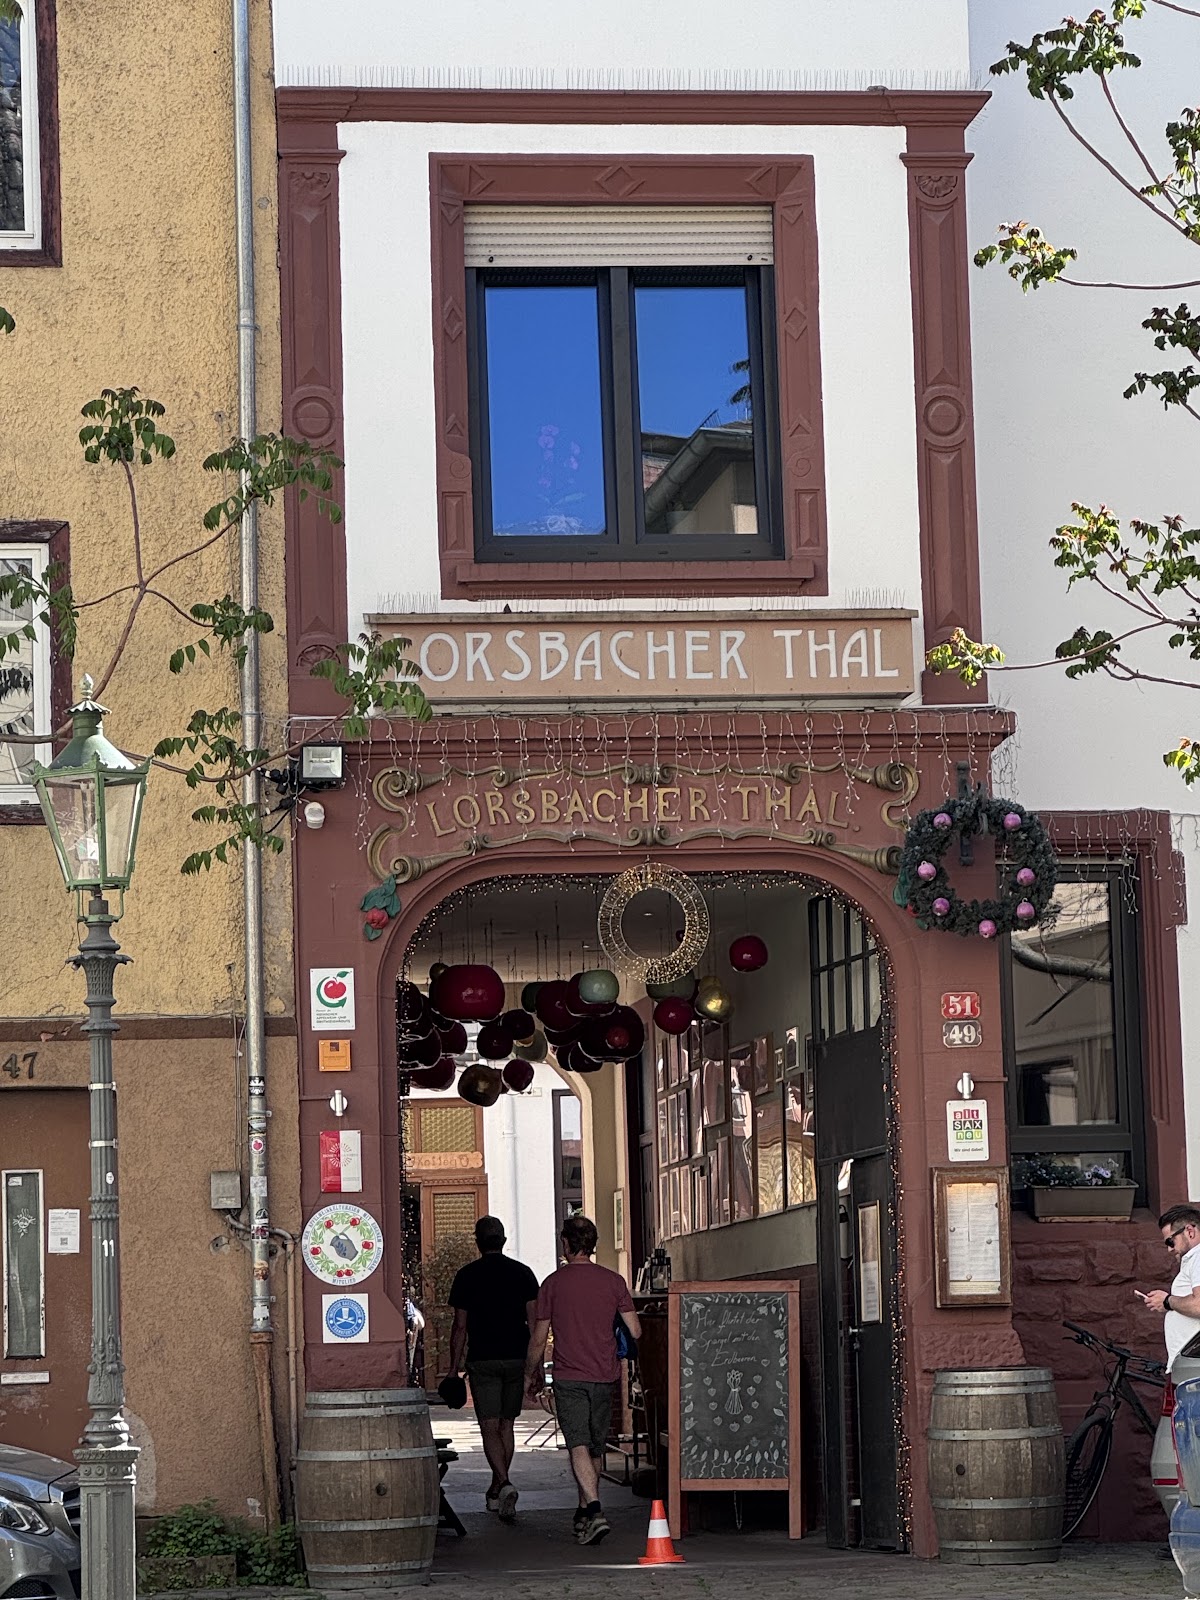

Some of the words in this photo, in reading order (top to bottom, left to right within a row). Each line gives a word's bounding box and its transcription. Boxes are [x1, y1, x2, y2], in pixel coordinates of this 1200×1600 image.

[773, 628, 899, 679] THAL
[425, 787, 711, 837] LORSBACHER
[948, 995, 974, 1016] 51
[949, 1024, 976, 1044] 49
[2, 1051, 39, 1079] 47
[954, 1109, 979, 1119] alt
[953, 1120, 982, 1130] SAX
[956, 1131, 982, 1140] neu
[102, 1239, 115, 1257] 11
[332, 1277, 357, 1285] MITGLIED
[745, 1310, 763, 1324] der
[697, 1330, 733, 1354] Spargel
[731, 1331, 749, 1343] mit
[711, 1350, 758, 1367] Erdbeeren
